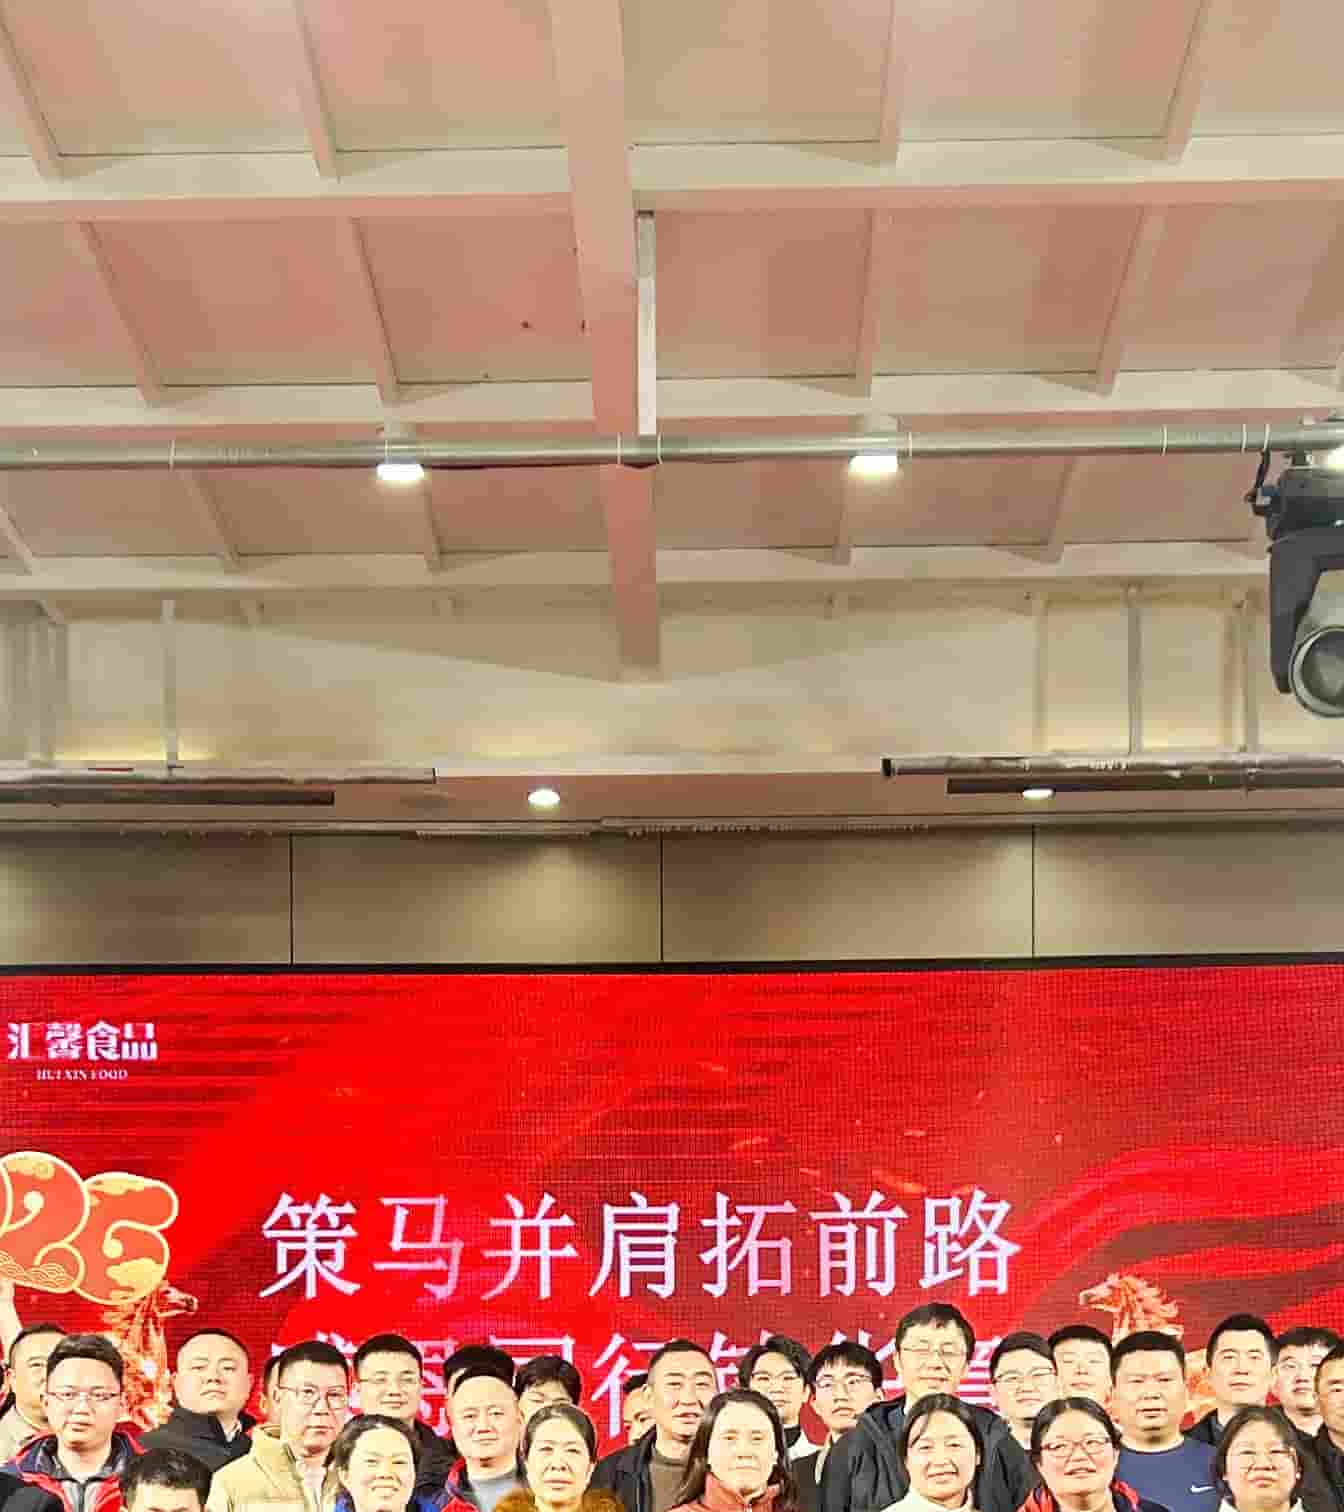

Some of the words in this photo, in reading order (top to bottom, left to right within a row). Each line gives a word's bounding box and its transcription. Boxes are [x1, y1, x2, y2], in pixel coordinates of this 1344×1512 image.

[7, 1021, 157, 1061] 汇馨食品
[259, 1190, 1022, 1300] 策马并肩拓前路
